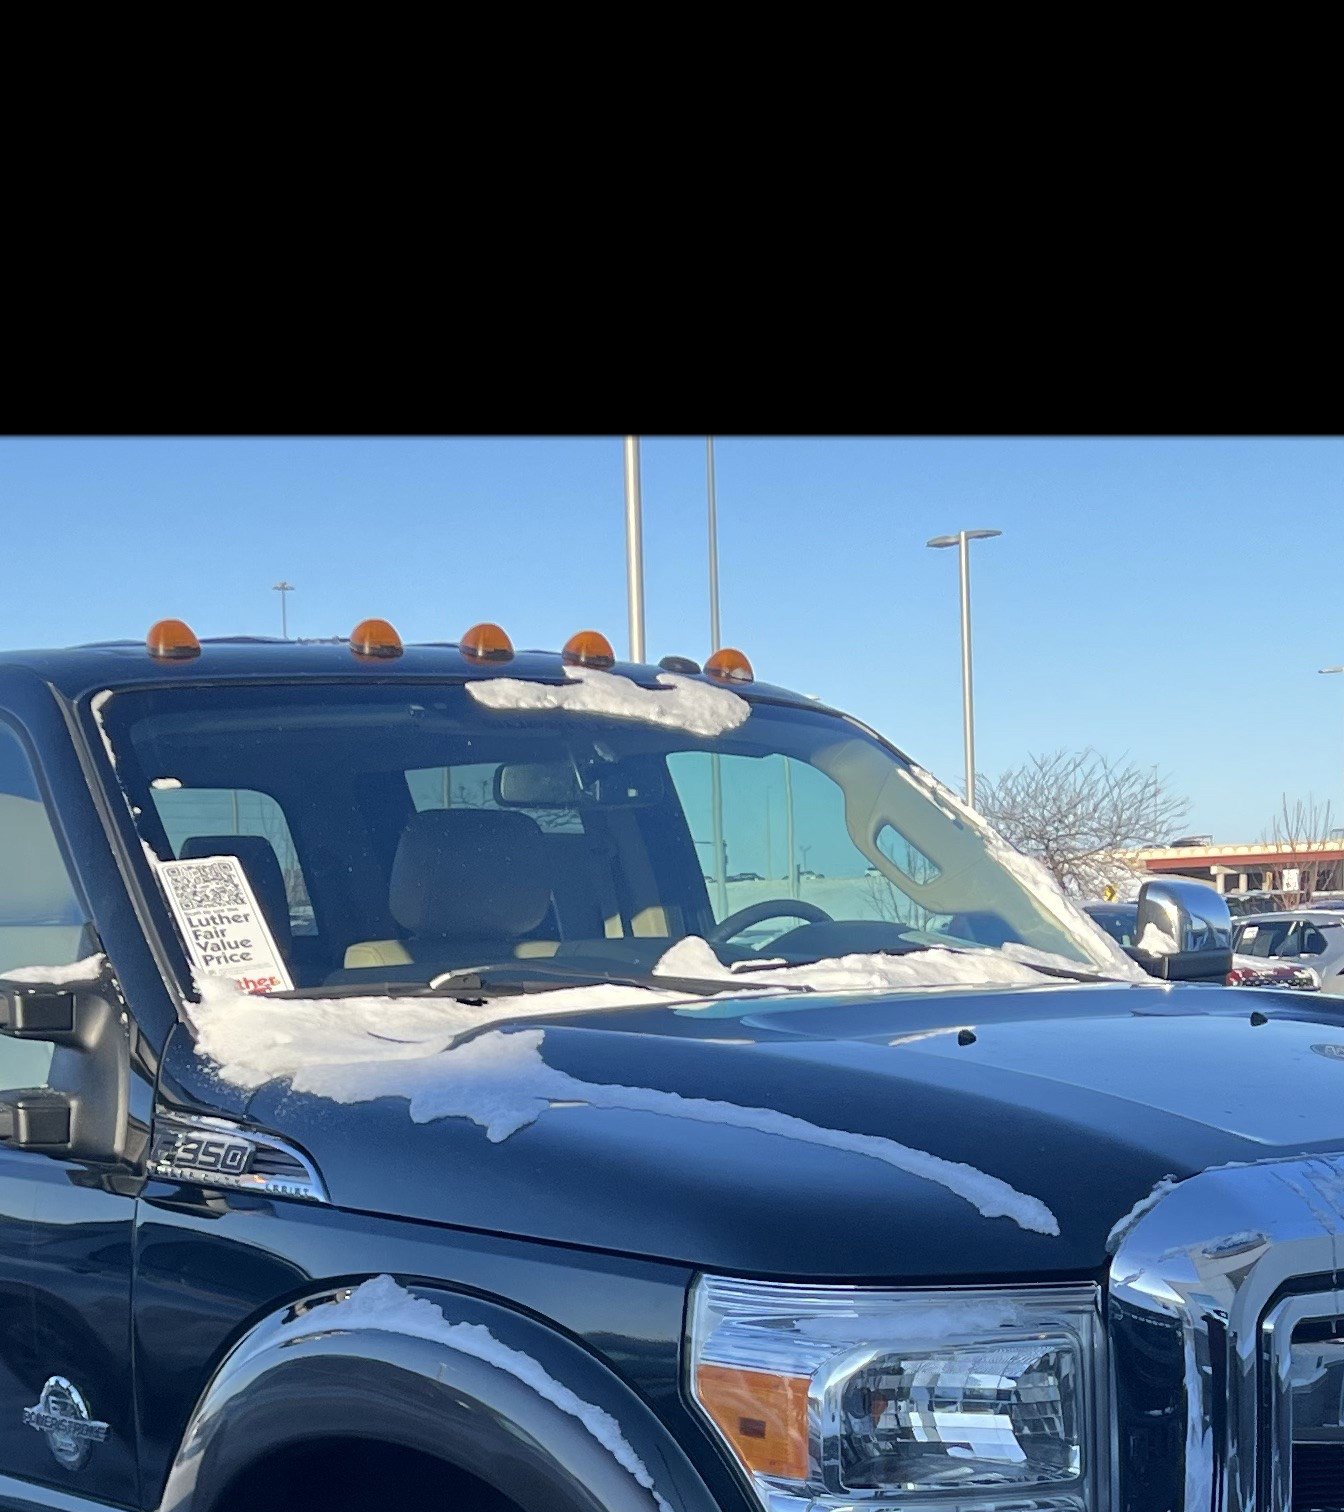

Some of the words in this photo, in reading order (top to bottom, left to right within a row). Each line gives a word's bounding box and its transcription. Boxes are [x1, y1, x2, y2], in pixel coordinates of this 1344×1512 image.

[186, 912, 250, 928] Luther
[192, 925, 227, 941] Fair
[196, 938, 253, 953] Value
[201, 951, 253, 967] Price
[235, 976, 277, 991] ther
[150, 1132, 251, 1175] F350
